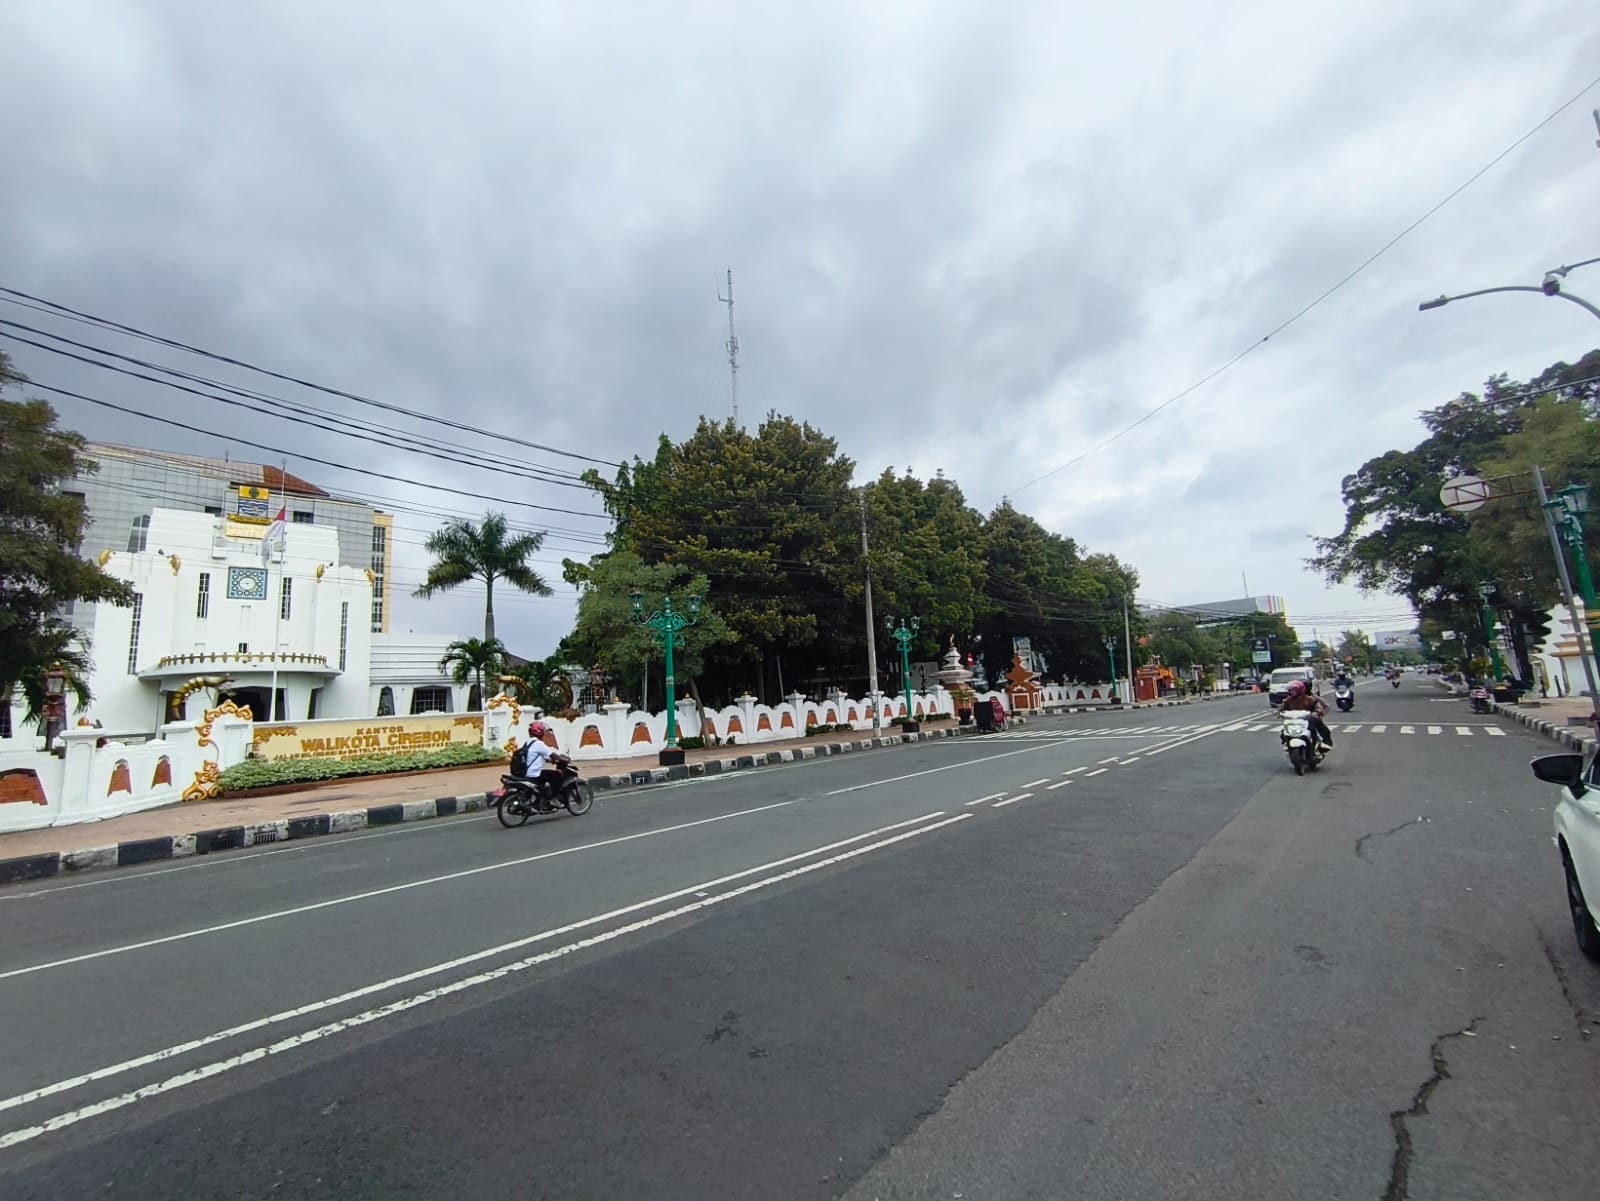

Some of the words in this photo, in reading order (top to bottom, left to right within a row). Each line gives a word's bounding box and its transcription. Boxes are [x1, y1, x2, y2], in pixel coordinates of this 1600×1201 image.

[357, 726, 404, 735] KANTOR
[301, 735, 381, 752] WALIKOTA
[388, 730, 451, 745] CIREBON
